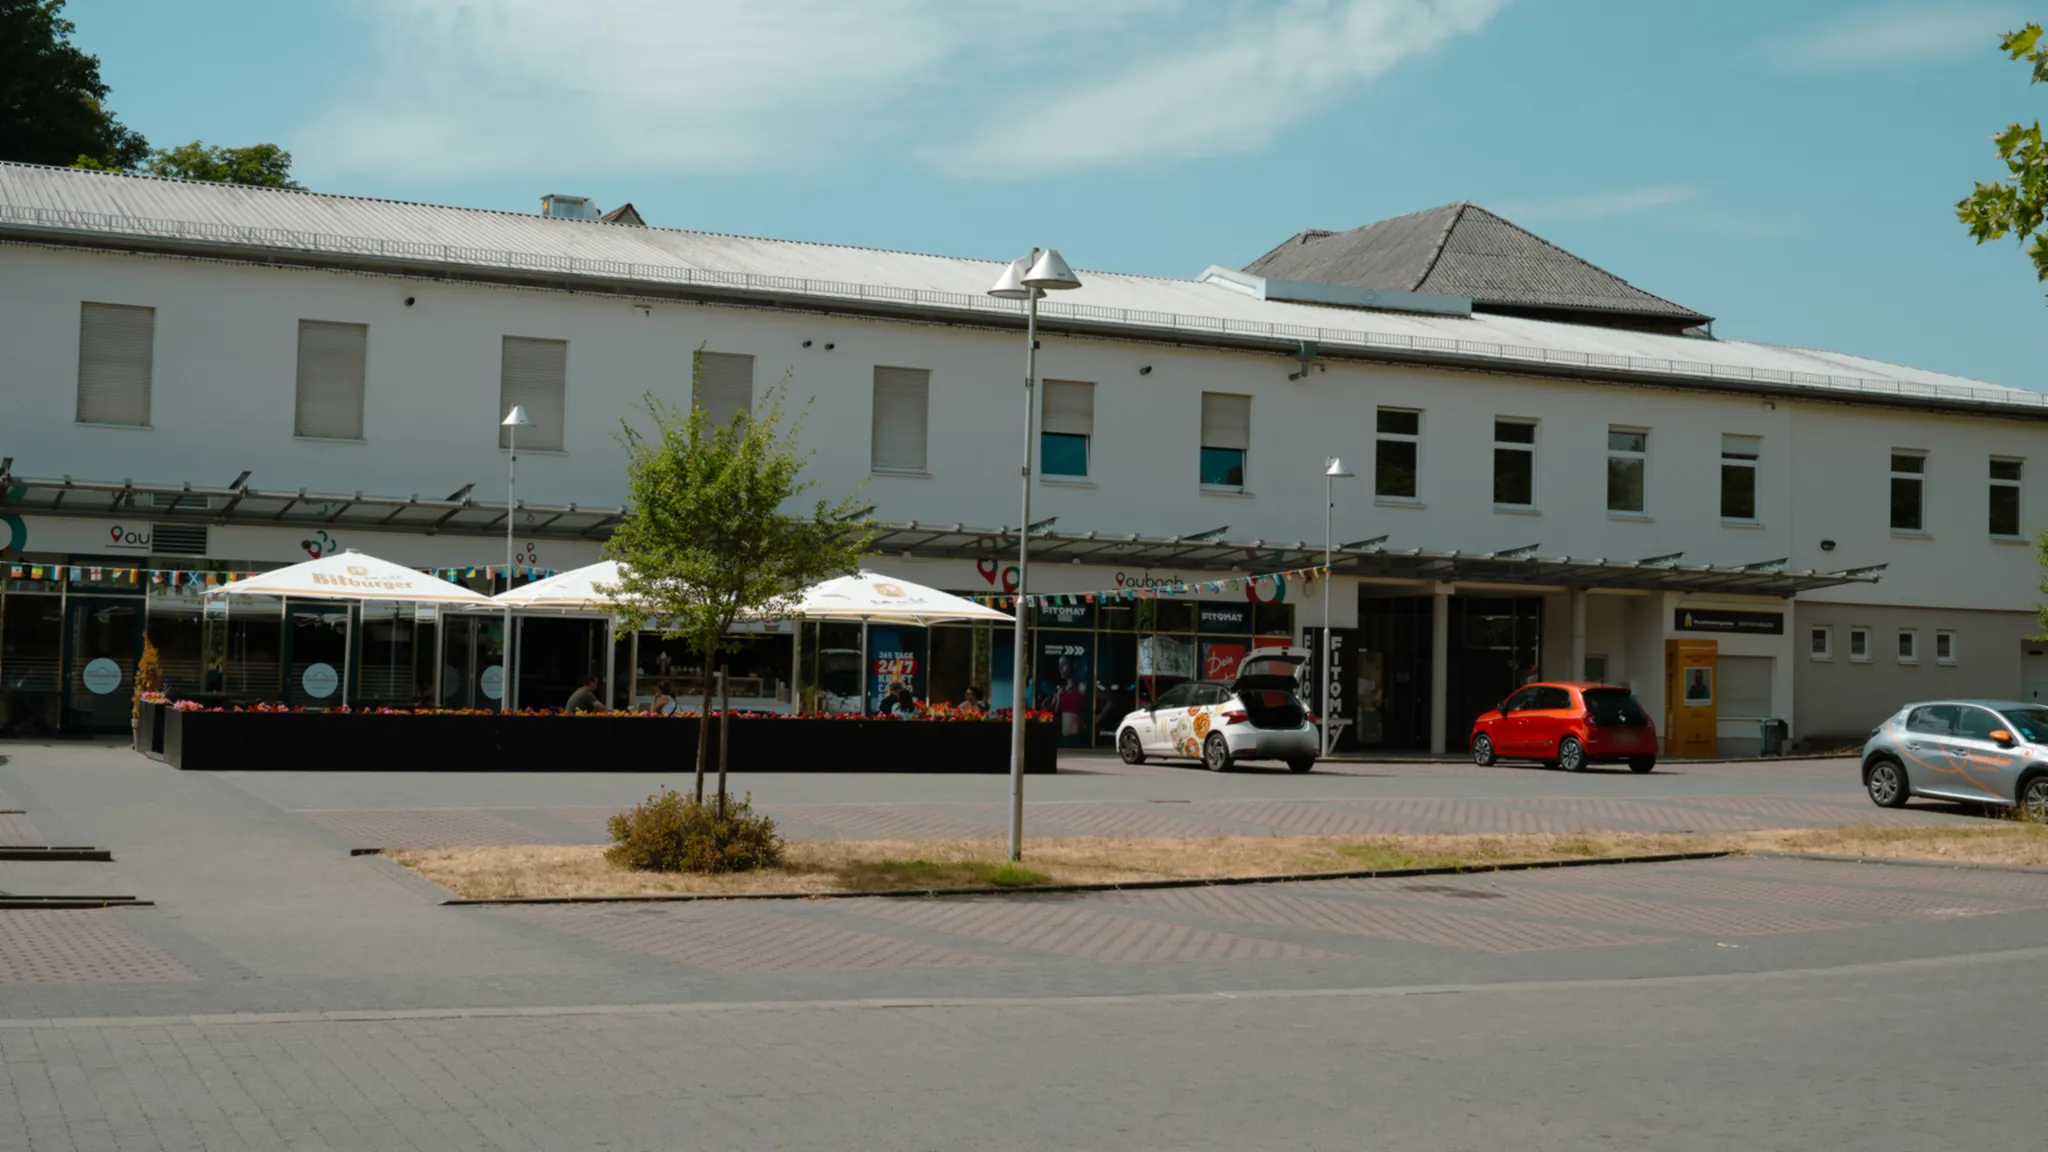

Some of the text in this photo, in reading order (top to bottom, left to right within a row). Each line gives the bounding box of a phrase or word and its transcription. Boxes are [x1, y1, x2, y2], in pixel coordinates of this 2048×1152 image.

[311, 572, 414, 590] Bitburger
[1042, 606, 1086, 616] FITOMAT
[1201, 612, 1244, 622] FITOMAT
[878, 651, 915, 660] 365 TAGE
[878, 674, 913, 683] KRFT
